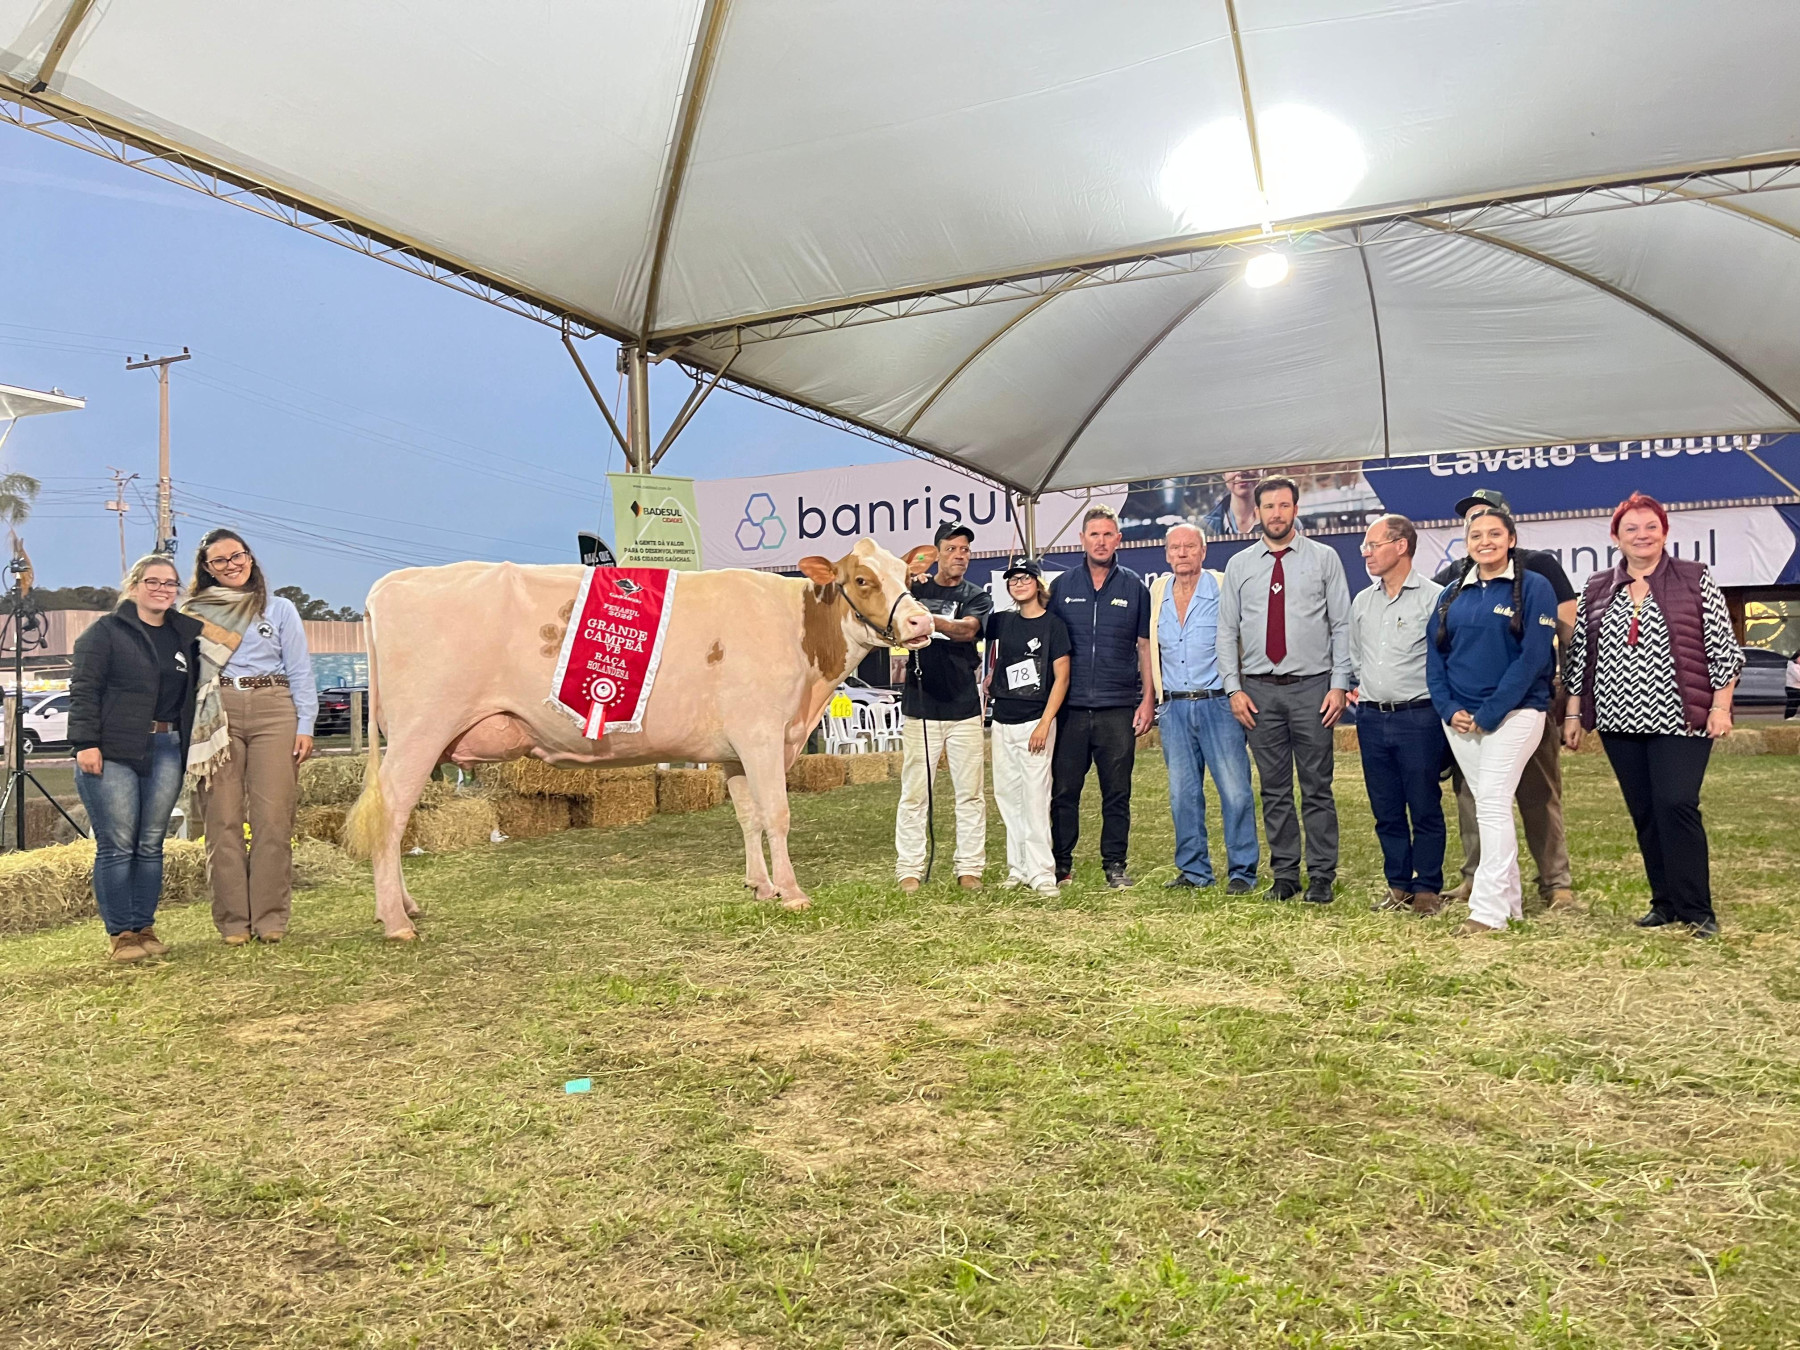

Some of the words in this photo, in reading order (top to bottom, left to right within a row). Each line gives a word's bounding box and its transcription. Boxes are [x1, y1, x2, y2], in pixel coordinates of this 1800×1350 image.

[643, 507, 682, 516] BADESUL
[798, 485, 1011, 539] banrisul
[603, 603, 640, 617] FENASUL
[587, 618, 648, 642] GRANDE
[594, 652, 627, 668] RAÇA
[586, 660, 629, 680] HOLANDESA
[1011, 667, 1030, 684] 78
[832, 703, 851, 717] 116
